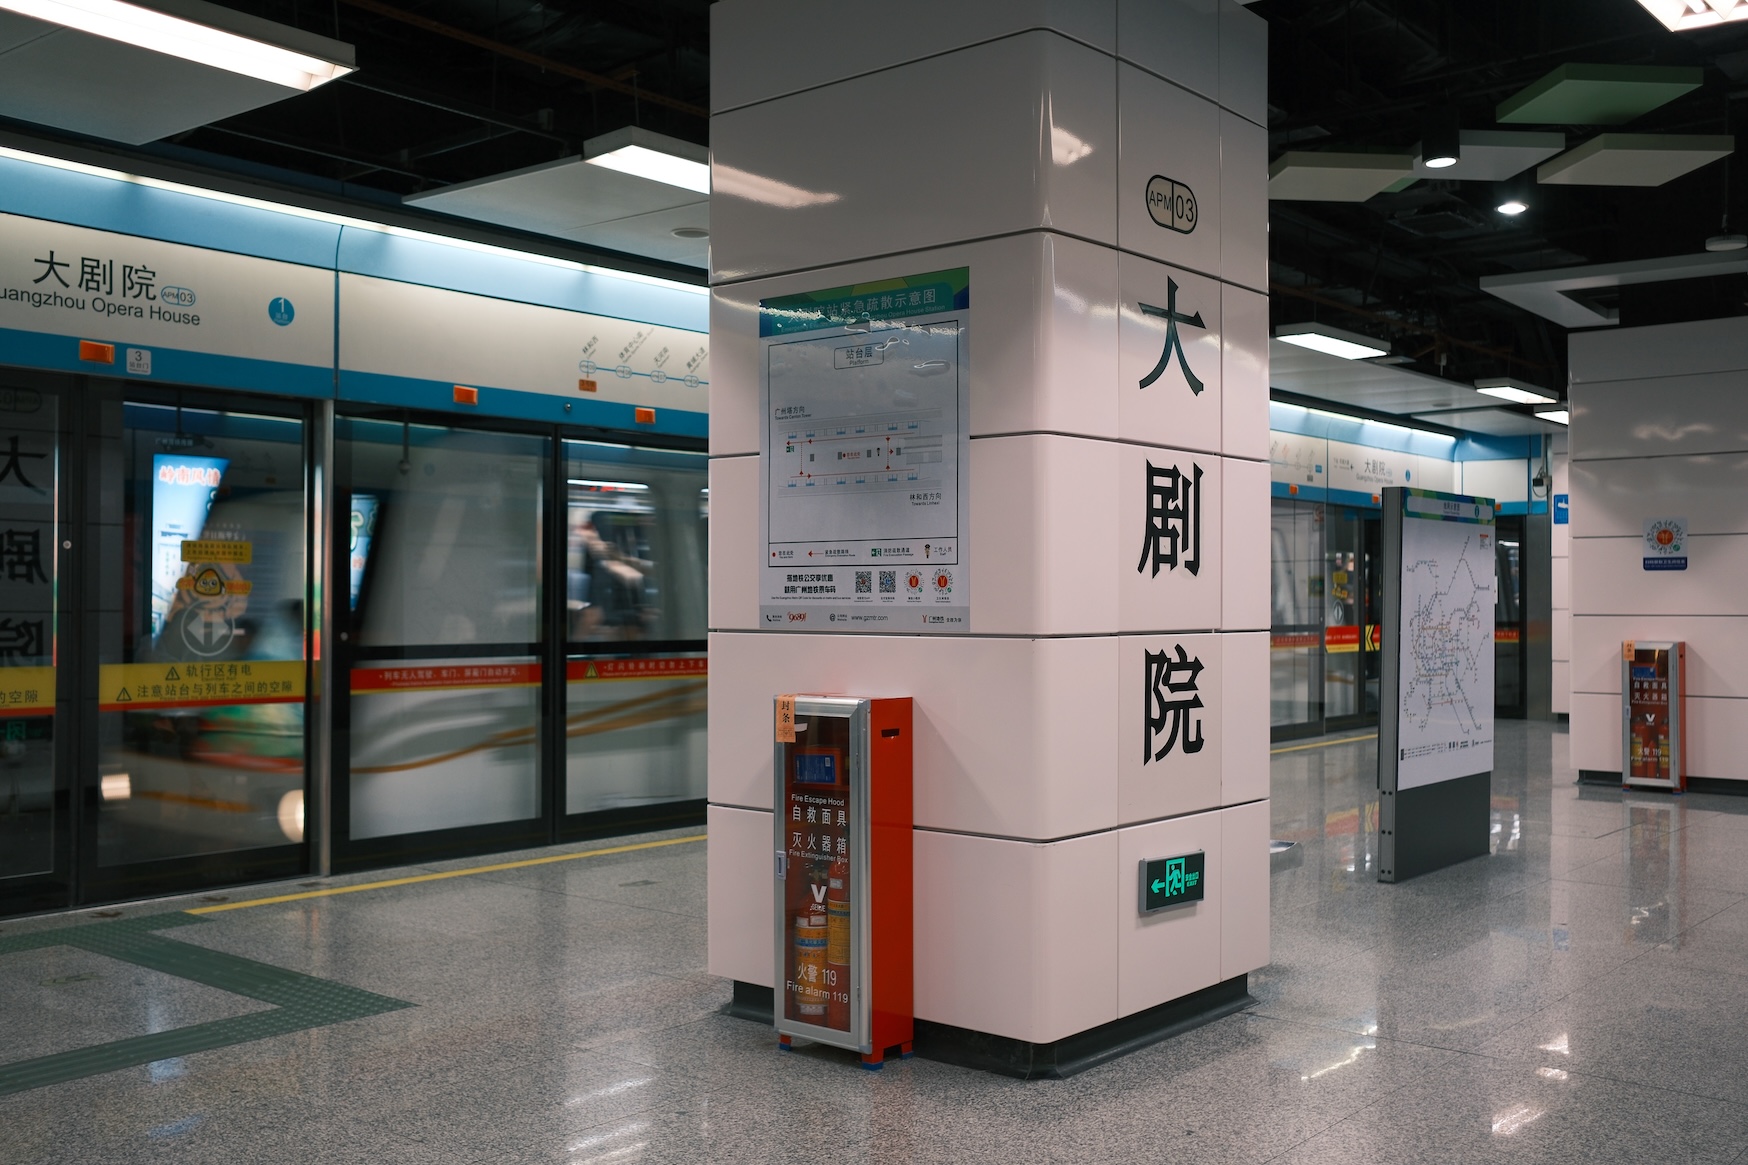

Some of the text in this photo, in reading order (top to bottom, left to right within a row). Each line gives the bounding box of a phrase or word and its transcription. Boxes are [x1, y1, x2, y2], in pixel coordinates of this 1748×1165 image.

[1149, 190, 1194, 223] APM 03
[32, 250, 157, 302] 大剧院
[180, 292, 193, 304] 03
[277, 298, 285, 313] 1
[92, 297, 143, 317] Opera
[149, 305, 200, 326] House
[135, 351, 142, 361] 3
[846, 346, 873, 359] 站台层
[849, 358, 870, 366] Platform
[774, 405, 806, 416] 广州塔方向
[909, 492, 942, 501] 林和西方向
[1137, 275, 1206, 767] 大剧院
[186, 664, 252, 677] 轨行区有电
[137, 681, 293, 698] 注意站台与列车之间的空隙
[781, 700, 790, 723] 封条
[1652, 748, 1662, 757] 119
[791, 793, 845, 806] Fire Escape Hood
[792, 804, 847, 827] 自救面具
[792, 831, 847, 855] 灭火器箱
[789, 849, 849, 863] Fire Extinguisher Box
[797, 962, 837, 987] 火警 119
[786, 980, 849, 1003] Fire alarm 119
